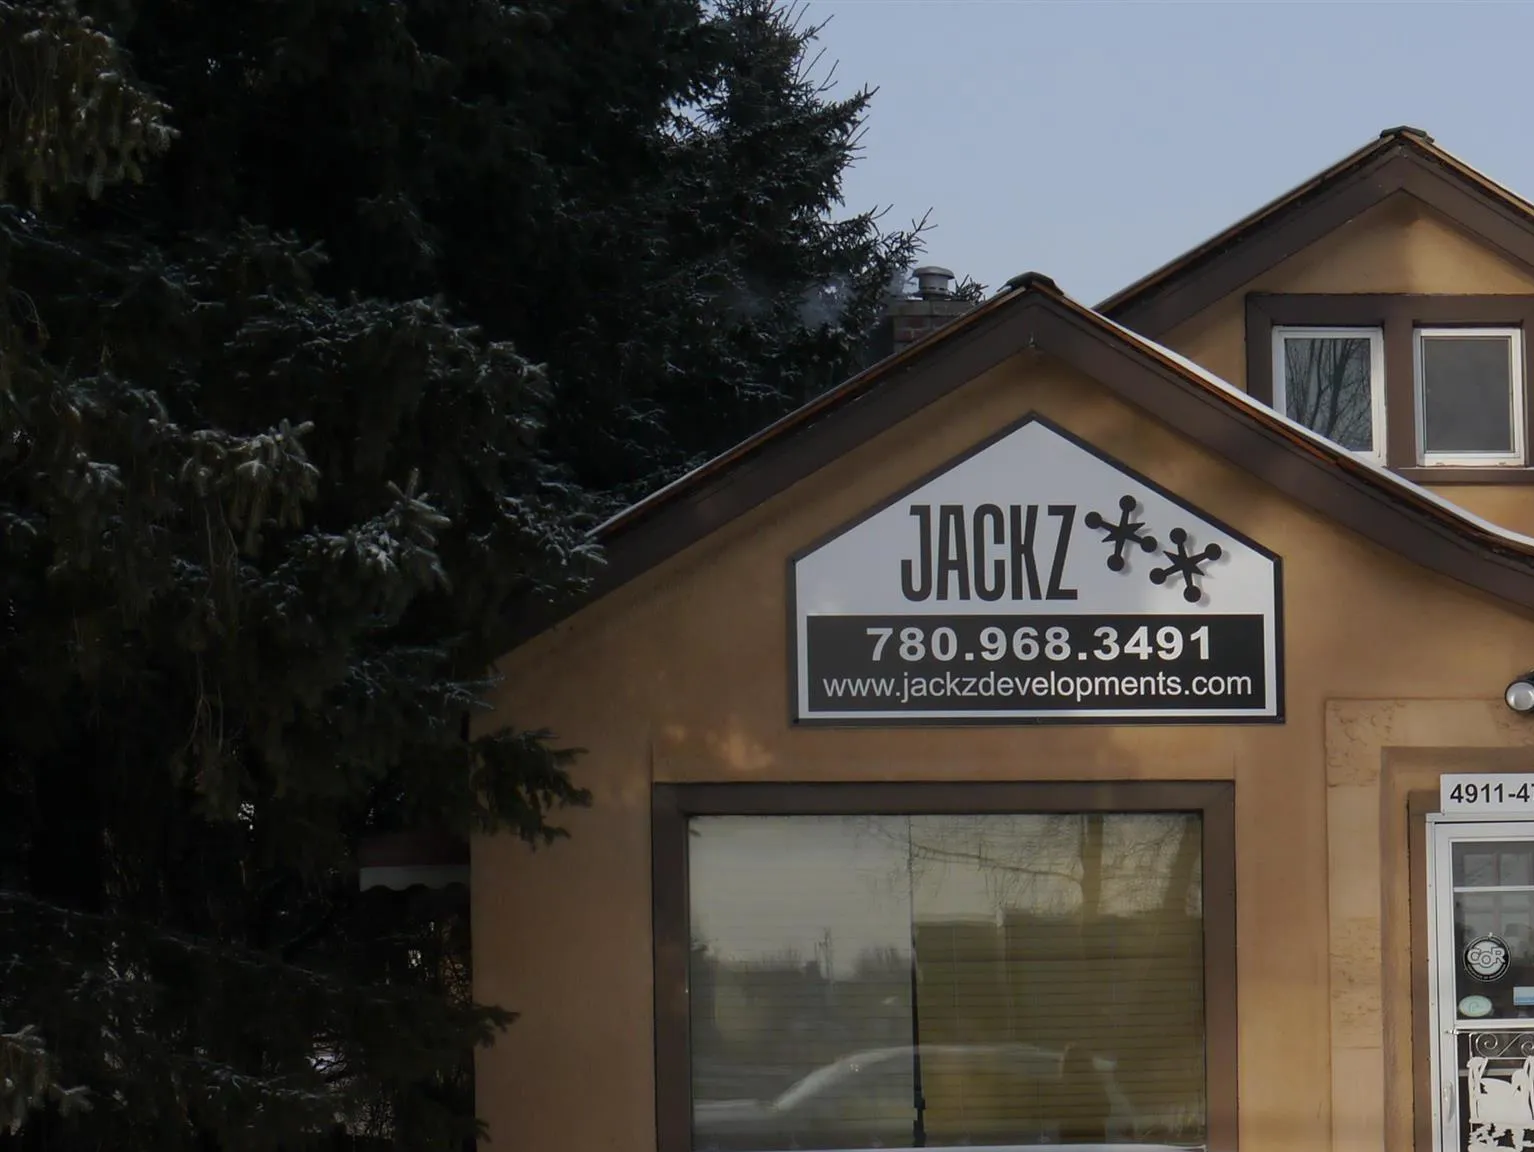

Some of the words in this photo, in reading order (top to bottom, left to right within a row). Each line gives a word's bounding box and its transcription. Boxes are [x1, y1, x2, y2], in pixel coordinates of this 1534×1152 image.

[900, 503, 1079, 602] JACKZ
[865, 625, 1211, 662] 780.968.3491
[822, 670, 1253, 703] www.jackzdevelopments.com
